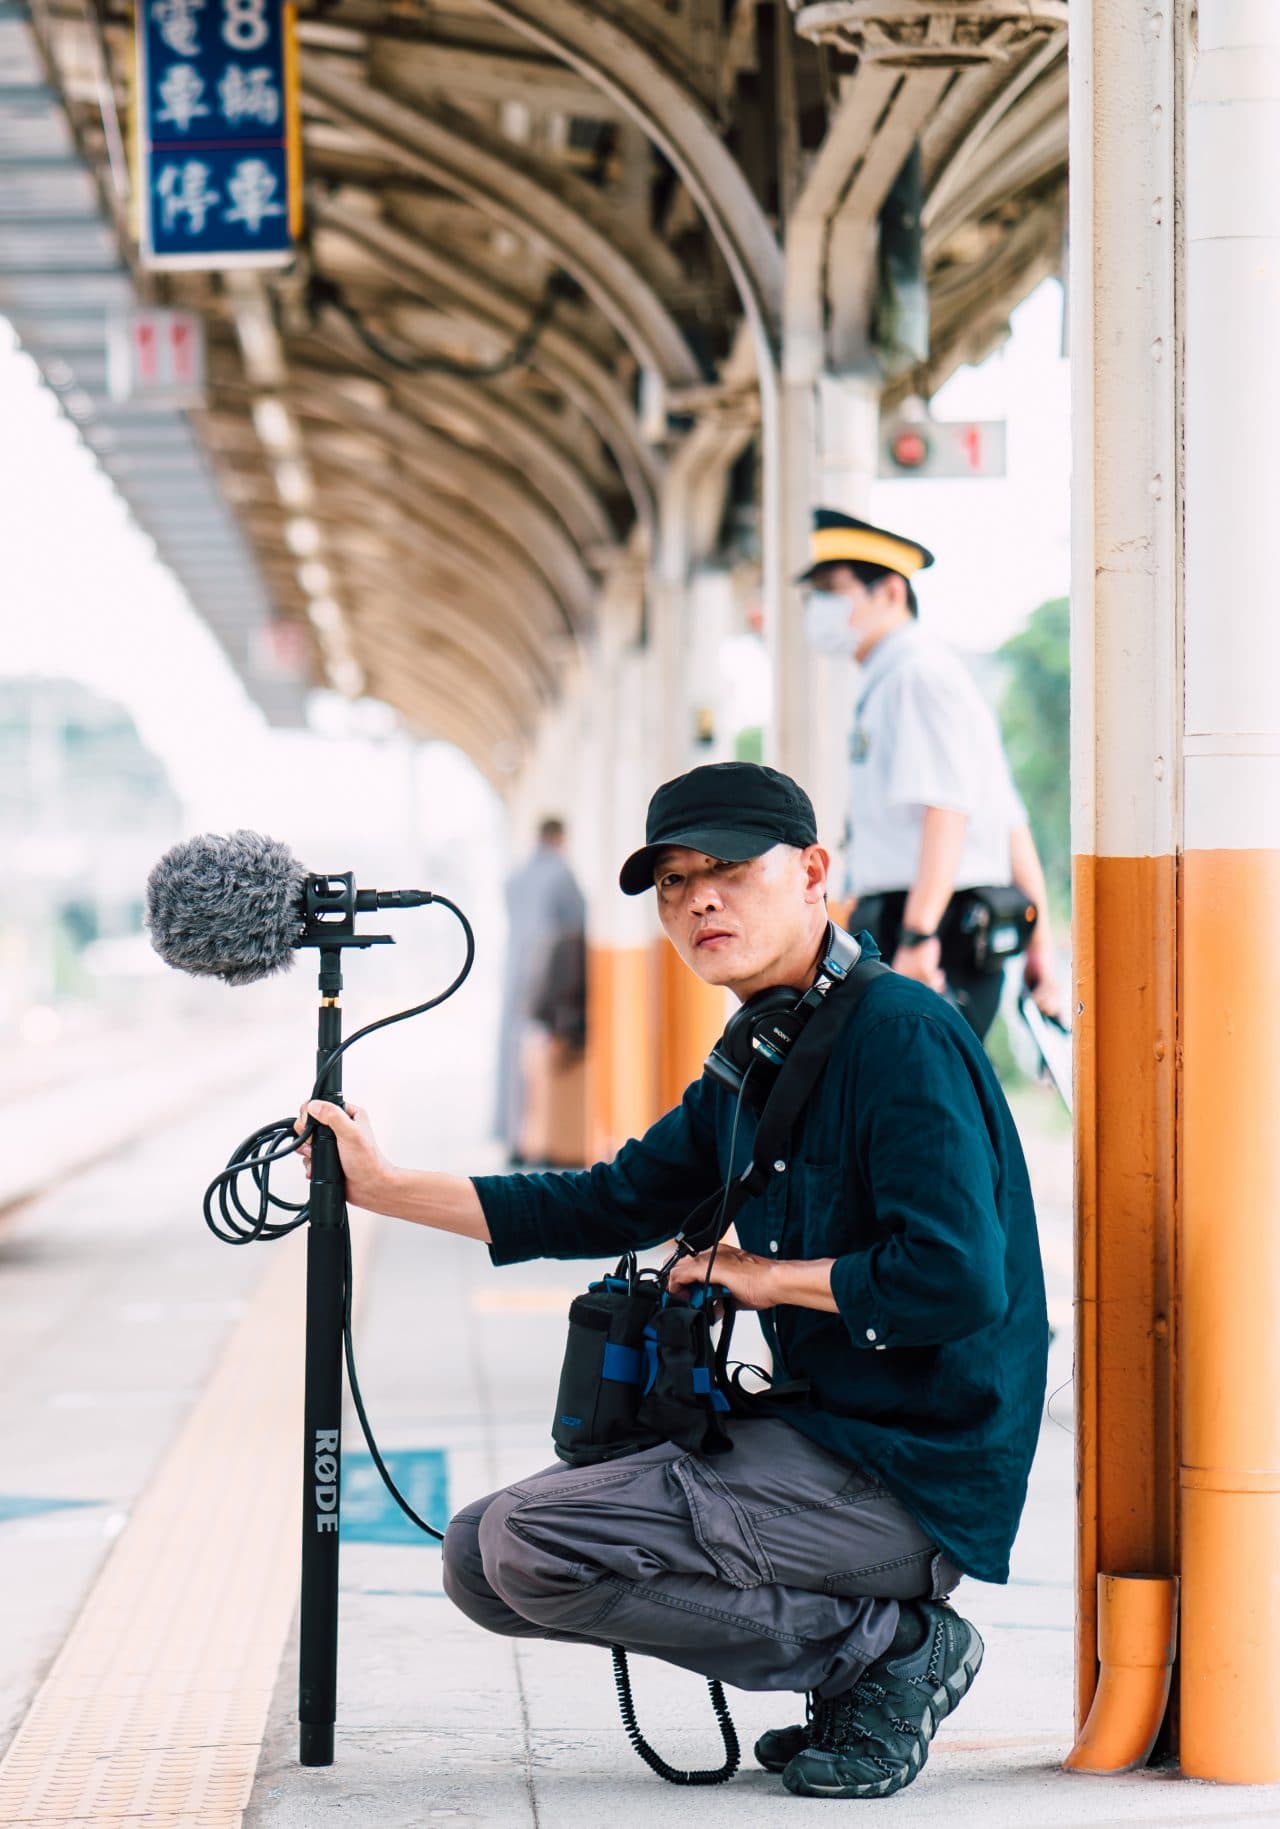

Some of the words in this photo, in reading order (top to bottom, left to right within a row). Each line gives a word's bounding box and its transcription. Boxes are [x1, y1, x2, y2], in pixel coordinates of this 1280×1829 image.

[157, 159, 285, 235] 停車
[956, 425, 981, 472] 1
[314, 1429, 339, 1532] RØDE
